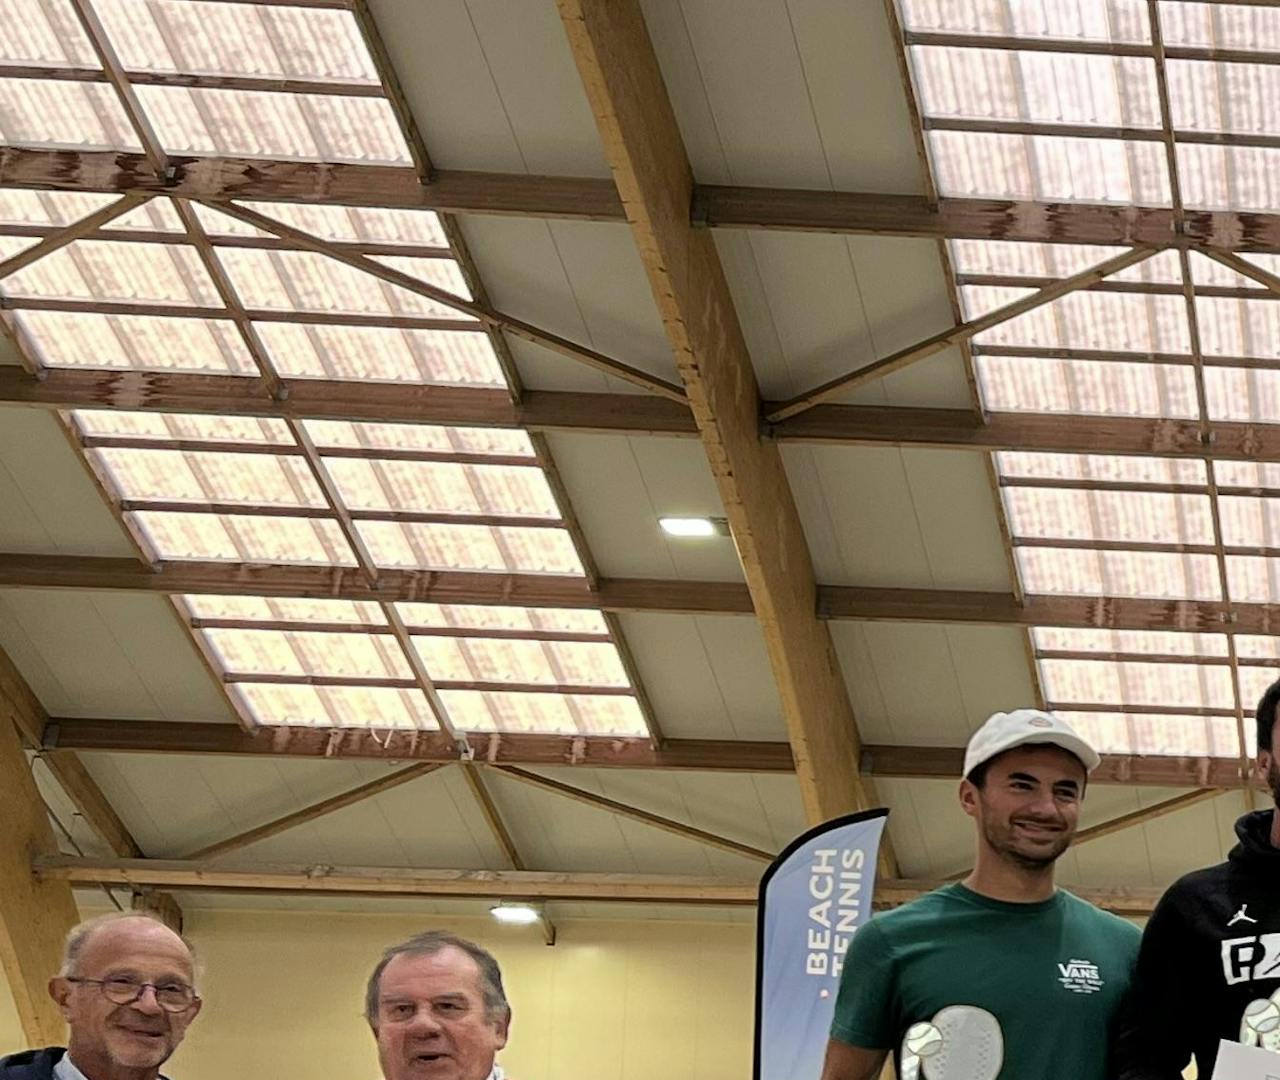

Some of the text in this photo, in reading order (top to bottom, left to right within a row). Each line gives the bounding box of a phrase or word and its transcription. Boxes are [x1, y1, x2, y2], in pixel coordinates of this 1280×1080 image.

[806, 849, 838, 975] BEACH
[832, 849, 864, 977] TENNIS
[1058, 963, 1100, 979] VANS
